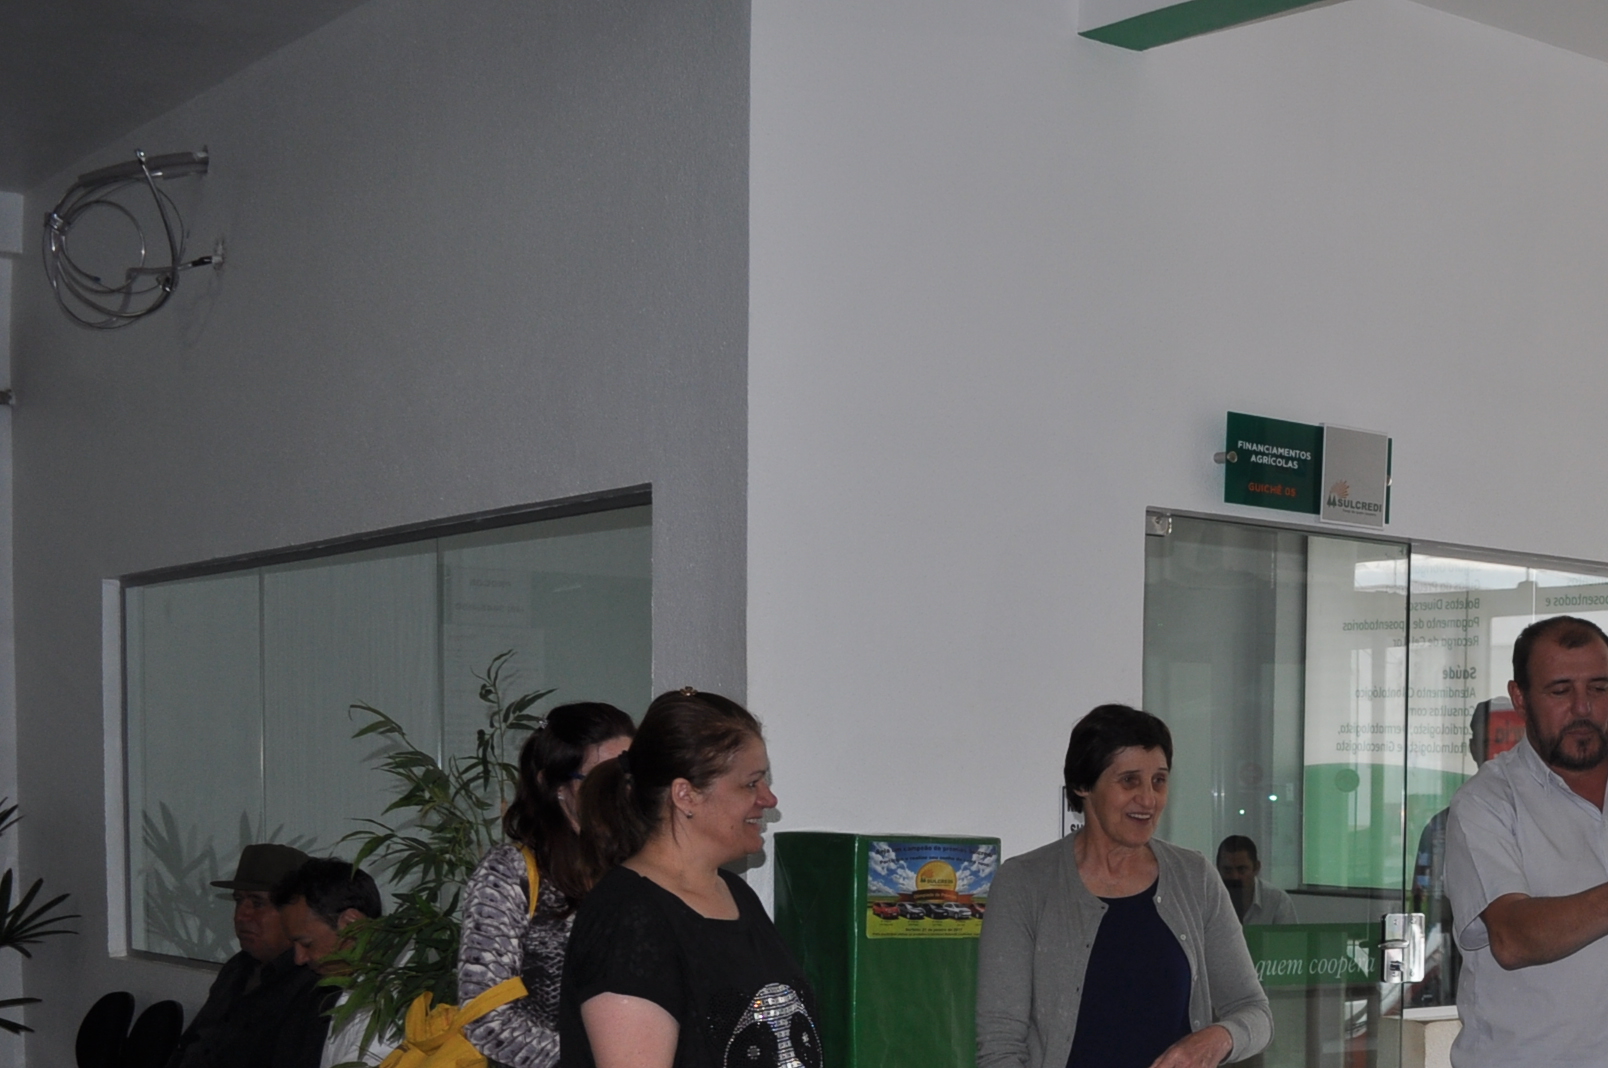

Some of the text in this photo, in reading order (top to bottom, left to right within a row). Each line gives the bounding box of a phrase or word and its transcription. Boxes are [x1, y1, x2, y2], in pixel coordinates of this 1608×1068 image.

[1237, 440, 1312, 460] FINANCIAMENTOS
[1250, 454, 1299, 469] AGRÍCOLAS
[1337, 497, 1382, 512] SULCREDI
[1255, 956, 1377, 982] quem coopera
